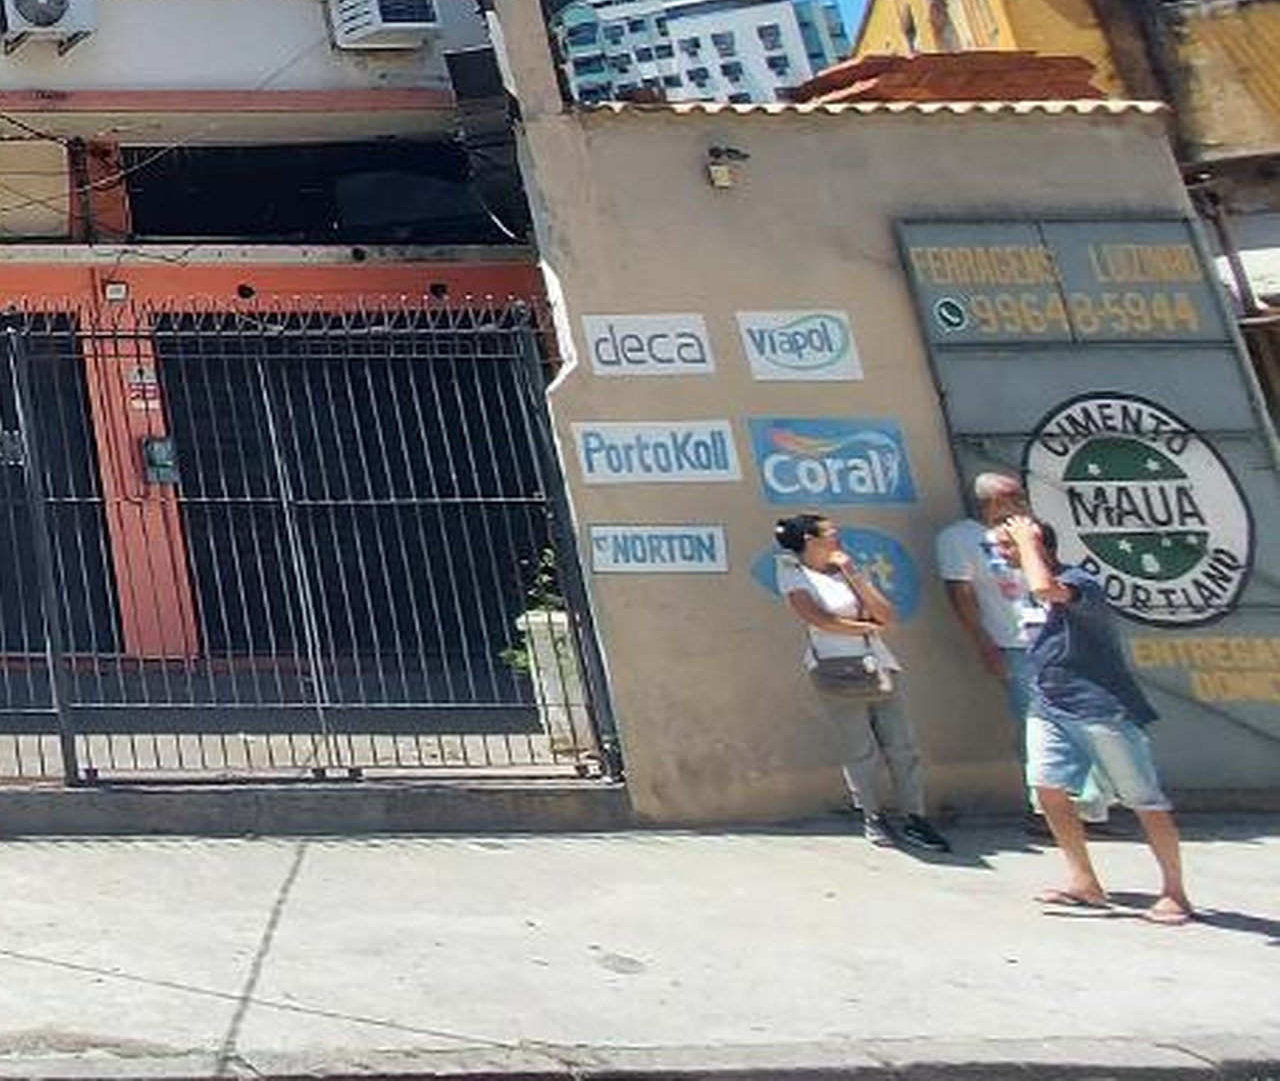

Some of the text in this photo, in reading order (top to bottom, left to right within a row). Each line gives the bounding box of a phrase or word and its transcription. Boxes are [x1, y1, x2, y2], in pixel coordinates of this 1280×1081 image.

[595, 324, 707, 367] deca
[1041, 403, 1188, 457] CIMENTO
[763, 450, 892, 495] Coral
[612, 532, 717, 565] NORTON
